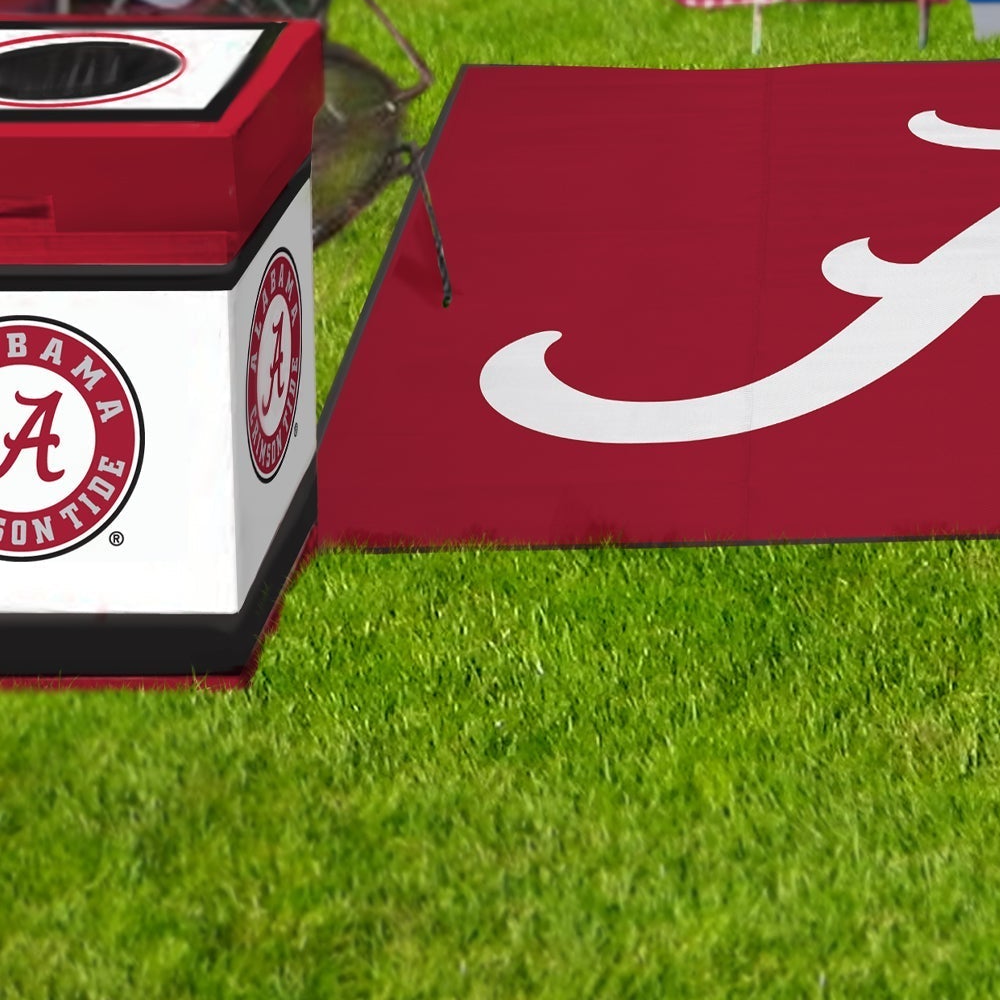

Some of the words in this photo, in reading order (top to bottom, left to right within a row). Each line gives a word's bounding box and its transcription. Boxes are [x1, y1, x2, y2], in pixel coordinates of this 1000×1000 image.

[250, 263, 298, 373] ALABAMA
[250, 404, 282, 468] CRIMSON
[283, 357, 299, 433] TIDE
[0, 515, 55, 546] ON
[58, 455, 126, 531] TIDE
